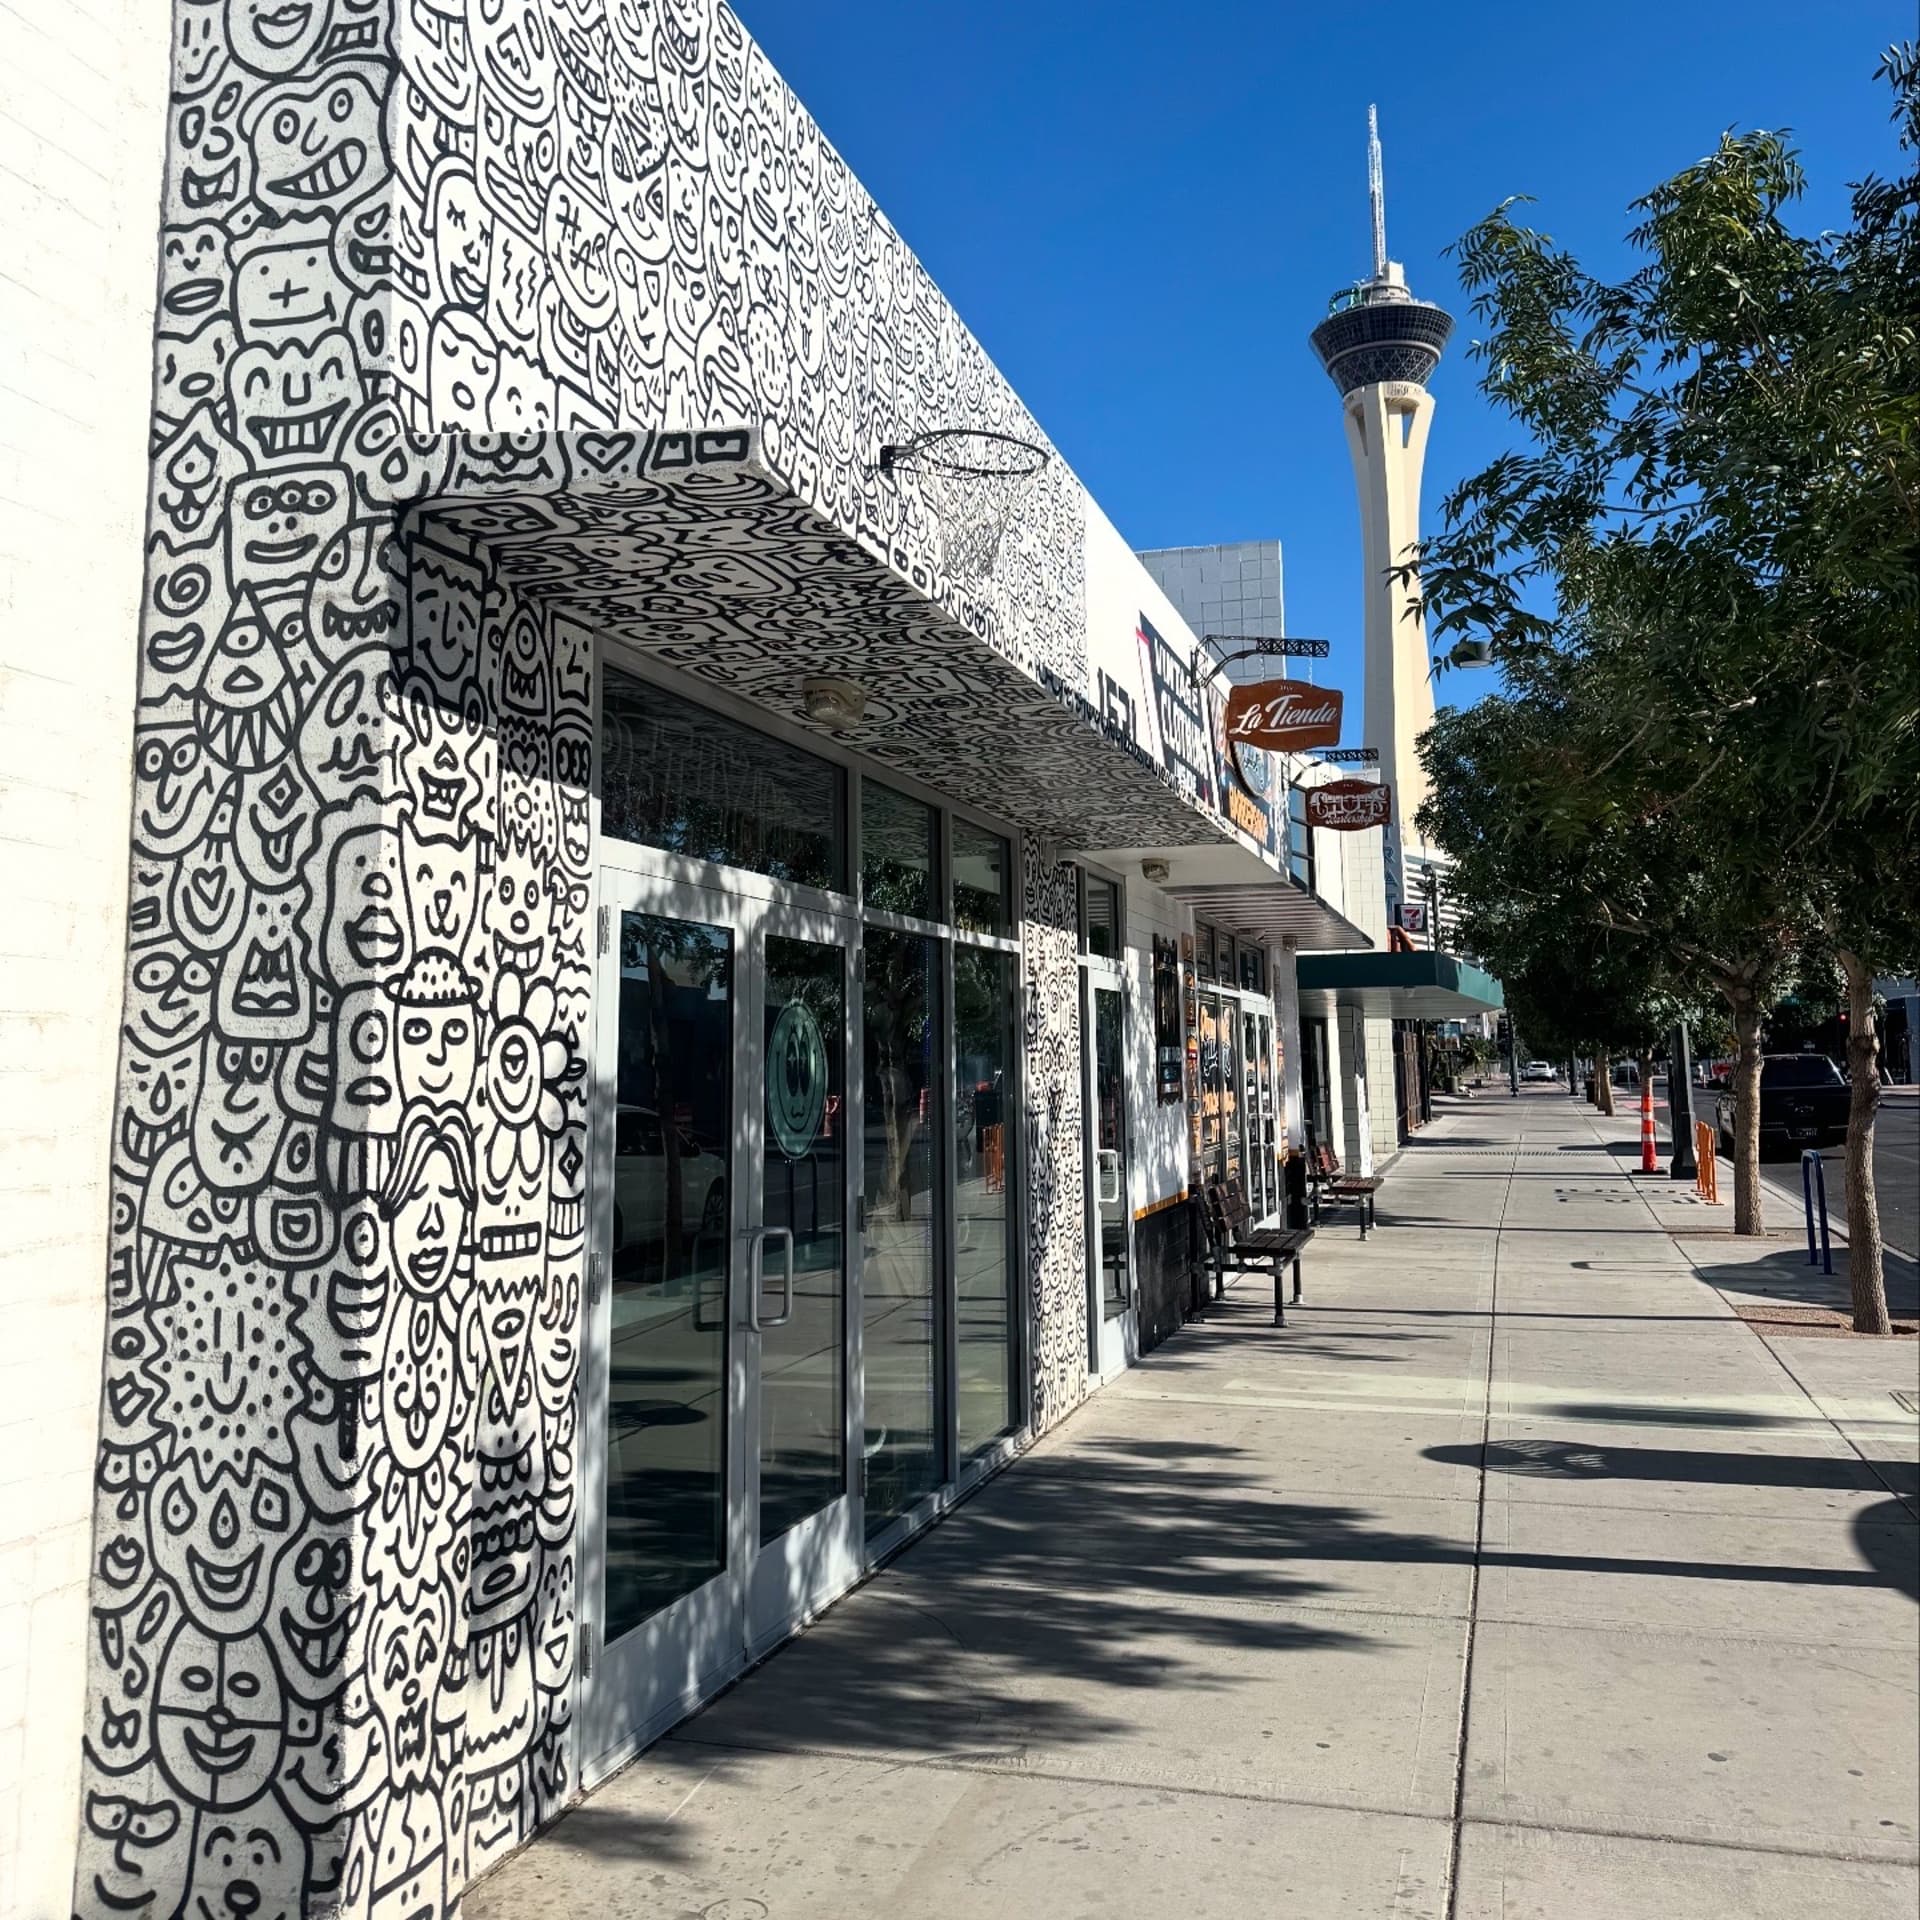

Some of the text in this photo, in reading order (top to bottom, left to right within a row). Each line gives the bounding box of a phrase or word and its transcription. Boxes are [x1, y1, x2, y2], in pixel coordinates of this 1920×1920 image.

[1154, 637, 1200, 717] VINTAGE
[1229, 694, 1338, 735] La Tienda
[1161, 689, 1209, 781] CLOTHING
[1382, 822, 1399, 913] TRAT
